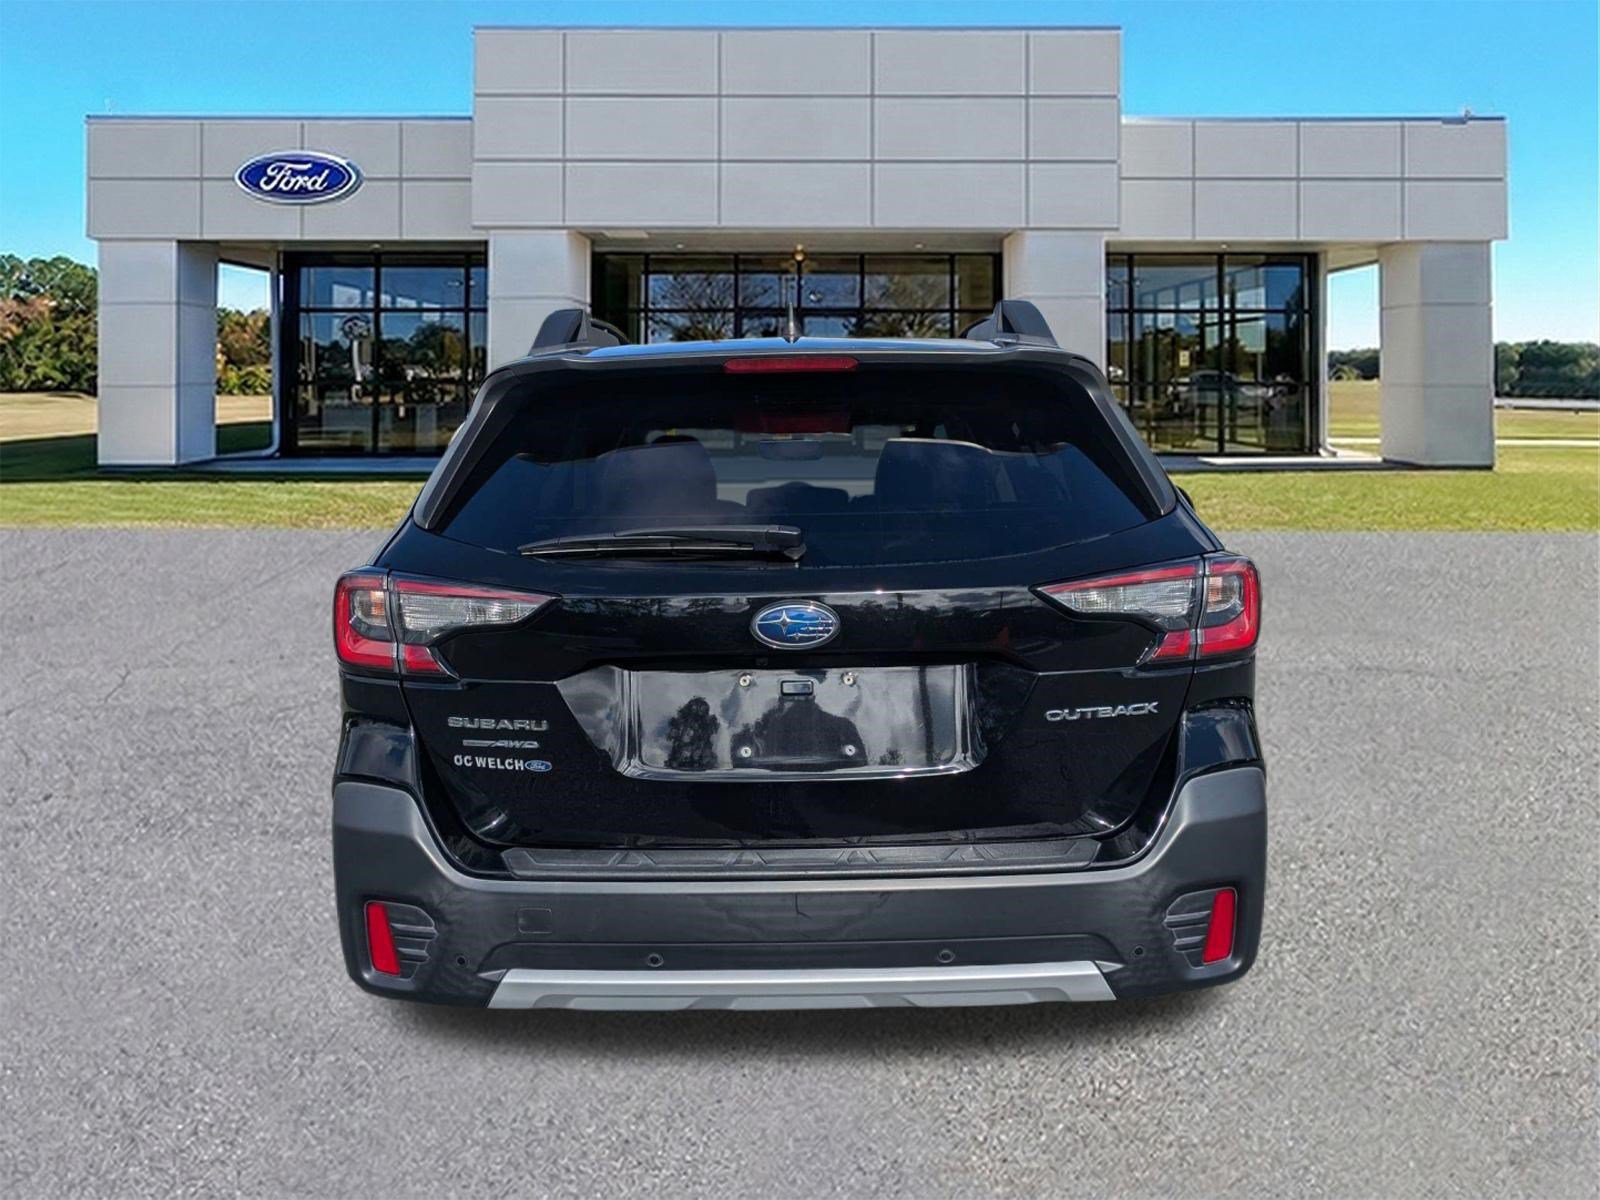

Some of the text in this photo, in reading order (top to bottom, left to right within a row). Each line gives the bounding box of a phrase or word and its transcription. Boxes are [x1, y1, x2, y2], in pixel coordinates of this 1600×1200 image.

[259, 161, 330, 192] Ford
[1045, 701, 1159, 721] OUTBACK
[447, 716, 549, 731] SUBARU
[453, 755, 473, 767] OC
[474, 757, 525, 771] WELCH
